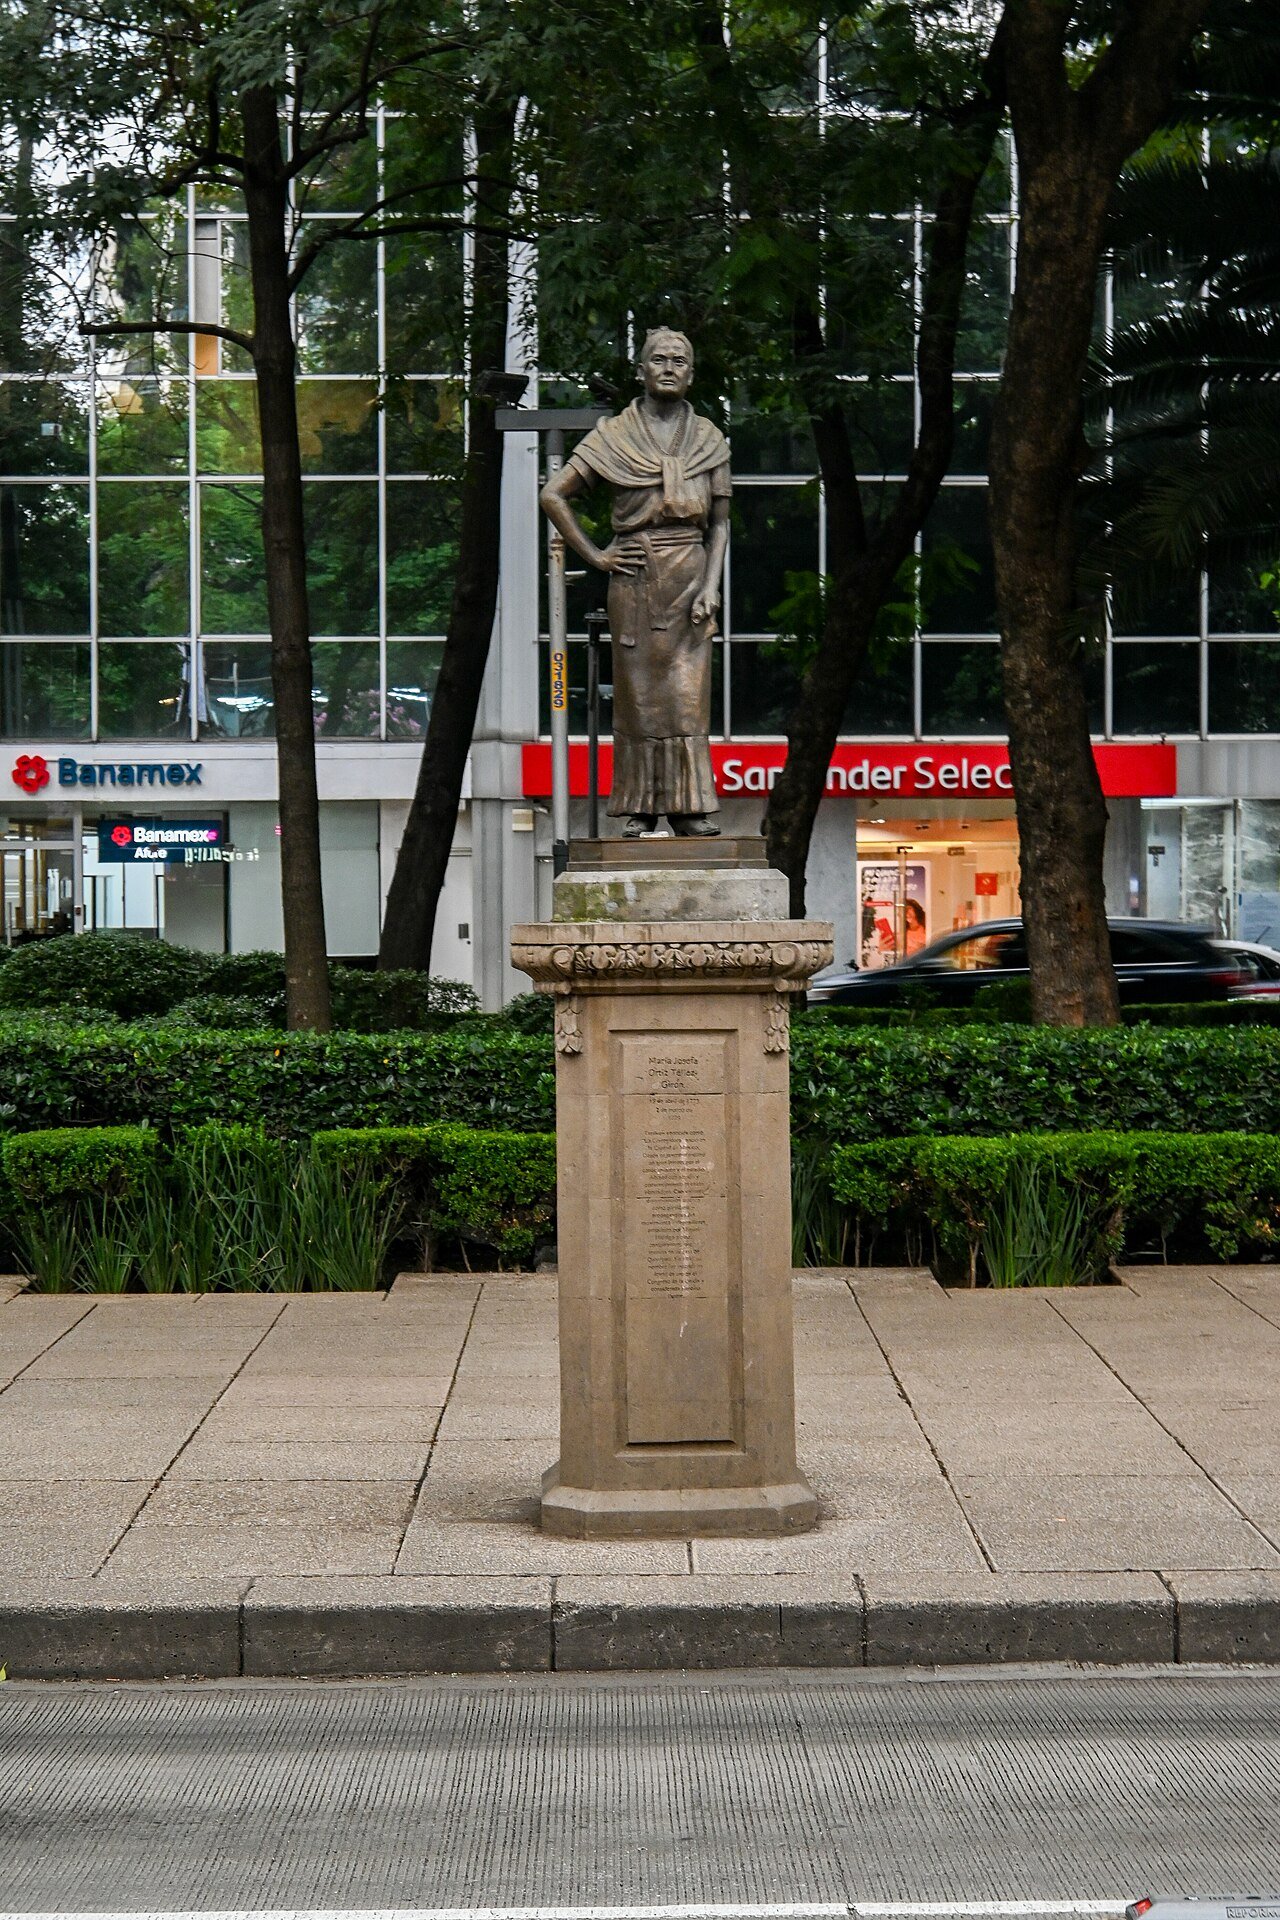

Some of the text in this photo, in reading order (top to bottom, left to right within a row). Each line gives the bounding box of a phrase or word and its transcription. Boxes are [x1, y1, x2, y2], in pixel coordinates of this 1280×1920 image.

[58, 758, 203, 786] Banamex
[722, 756, 1013, 792] Sannder Selec
[133, 827, 210, 843] Banamex
[673, 1055, 699, 1065] Josefa
[648, 1067, 669, 1077] Ortiz
[1226, 1907, 1280, 1918] REFORM
